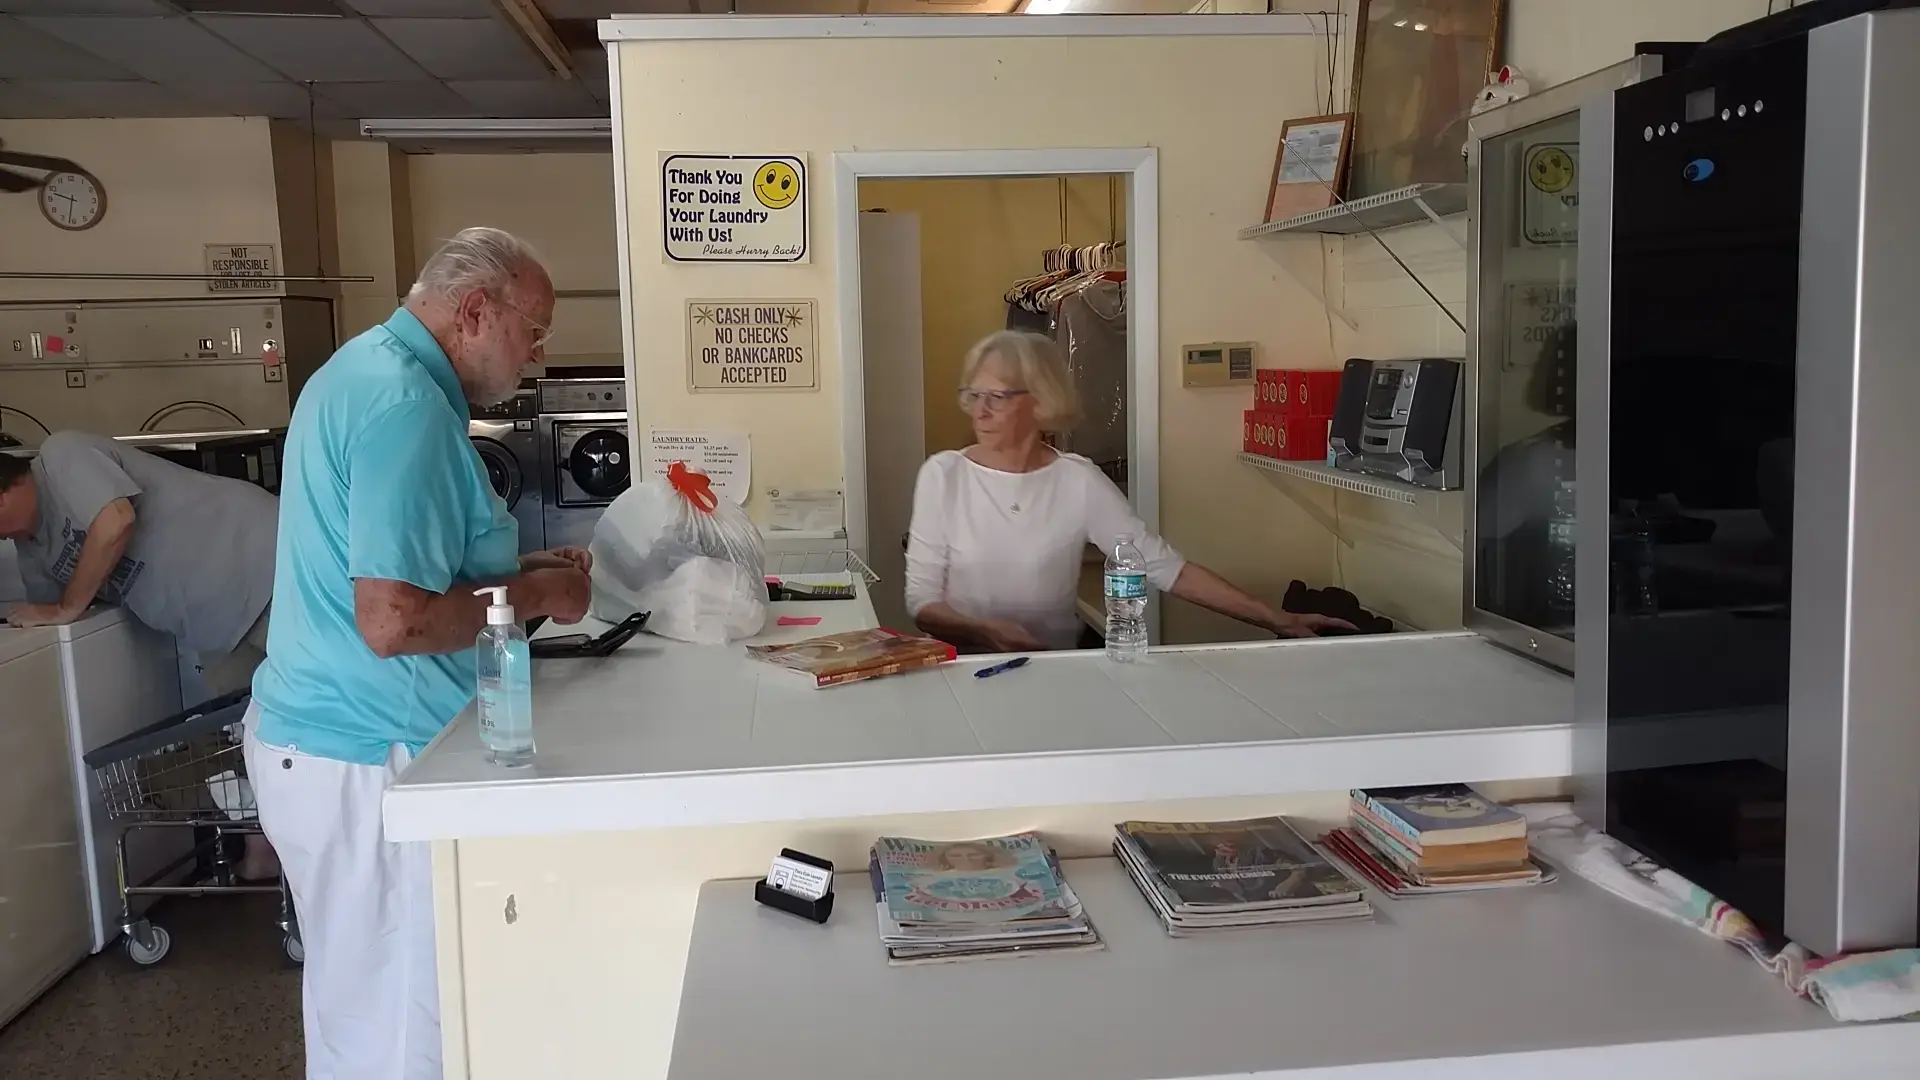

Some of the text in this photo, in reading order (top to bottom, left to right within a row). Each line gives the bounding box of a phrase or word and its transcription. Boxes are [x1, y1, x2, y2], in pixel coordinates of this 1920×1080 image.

[668, 168, 743, 185] Thank You
[669, 188, 742, 204] For Doing
[669, 208, 769, 224] Your Laundry
[669, 227, 733, 242] With Us!
[231, 247, 248, 258] NOT
[702, 244, 802, 258] Please Hurry Back!
[212, 259, 269, 271] RESPONSIBLE
[214, 279, 271, 290] STOLEN ARTICLES
[716, 307, 786, 324] CASH ONLY
[715, 327, 789, 344] NO CHECKS
[702, 346, 803, 364] OR BANKCARDS
[721, 366, 787, 384] ACCEPTED
[685, 436, 708, 444] RATES:
[1168, 873, 1192, 881] THE
[1192, 872, 1239, 881] EVICTION
